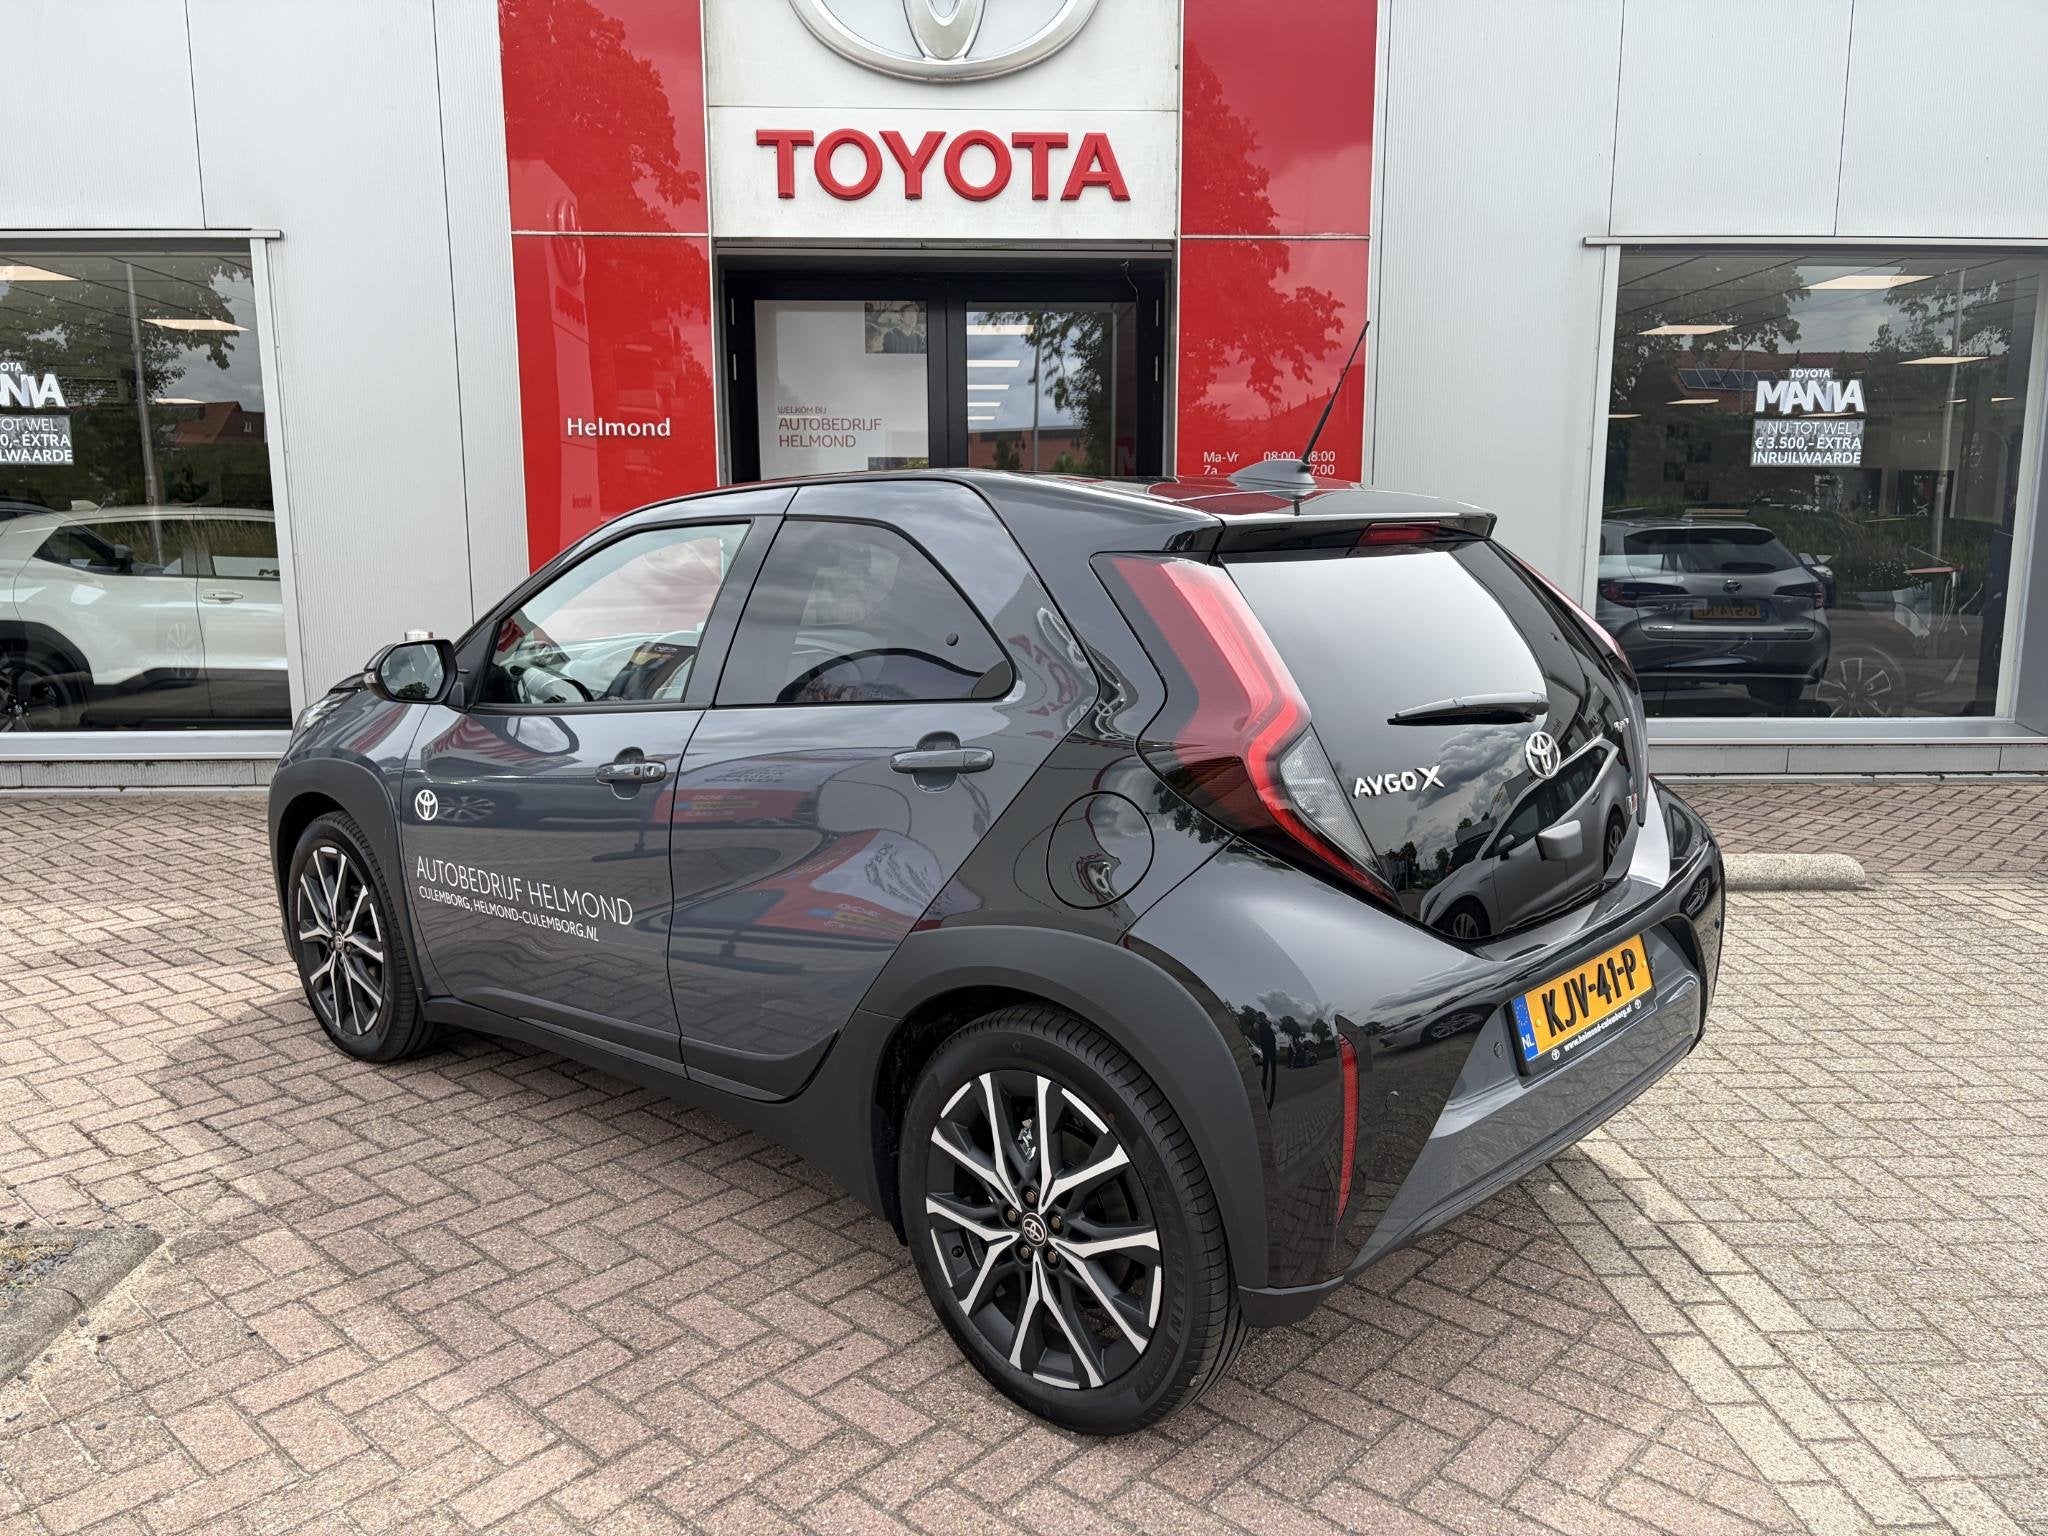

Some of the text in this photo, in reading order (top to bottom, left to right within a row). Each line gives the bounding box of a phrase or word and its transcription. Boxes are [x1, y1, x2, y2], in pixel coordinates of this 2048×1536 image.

[756, 128, 1131, 202] TOYOTA
[1790, 368, 1831, 378] TOYOTA
[1755, 379, 1865, 415] MANIA
[778, 406, 827, 414] WELKOM BIJ
[26, 418, 58, 431] WEL
[566, 417, 671, 437] Helmond
[779, 418, 882, 431] AUTOBEDRIJF
[1767, 422, 1852, 434] NU TOT WEL
[22, 431, 71, 447] ÉXTRA
[779, 434, 857, 448] HELMOND
[1816, 434, 1861, 449] ÉXTRA
[1203, 451, 1240, 463] Ma-Vr
[1263, 451, 1296, 460] 08:00
[1752, 451, 1862, 464] INRUILWAARDE
[417, 856, 633, 926] AUTOBEDRIJF HELMOND
[419, 885, 599, 942] CULEMBORG, HELMOND-CULEMBORG.NL
[1541, 948, 1637, 1038] KJV-41-P
[1563, 1003, 1632, 1052] www.helmond-culemborg.nl
[1521, 1034, 1535, 1050] NL
